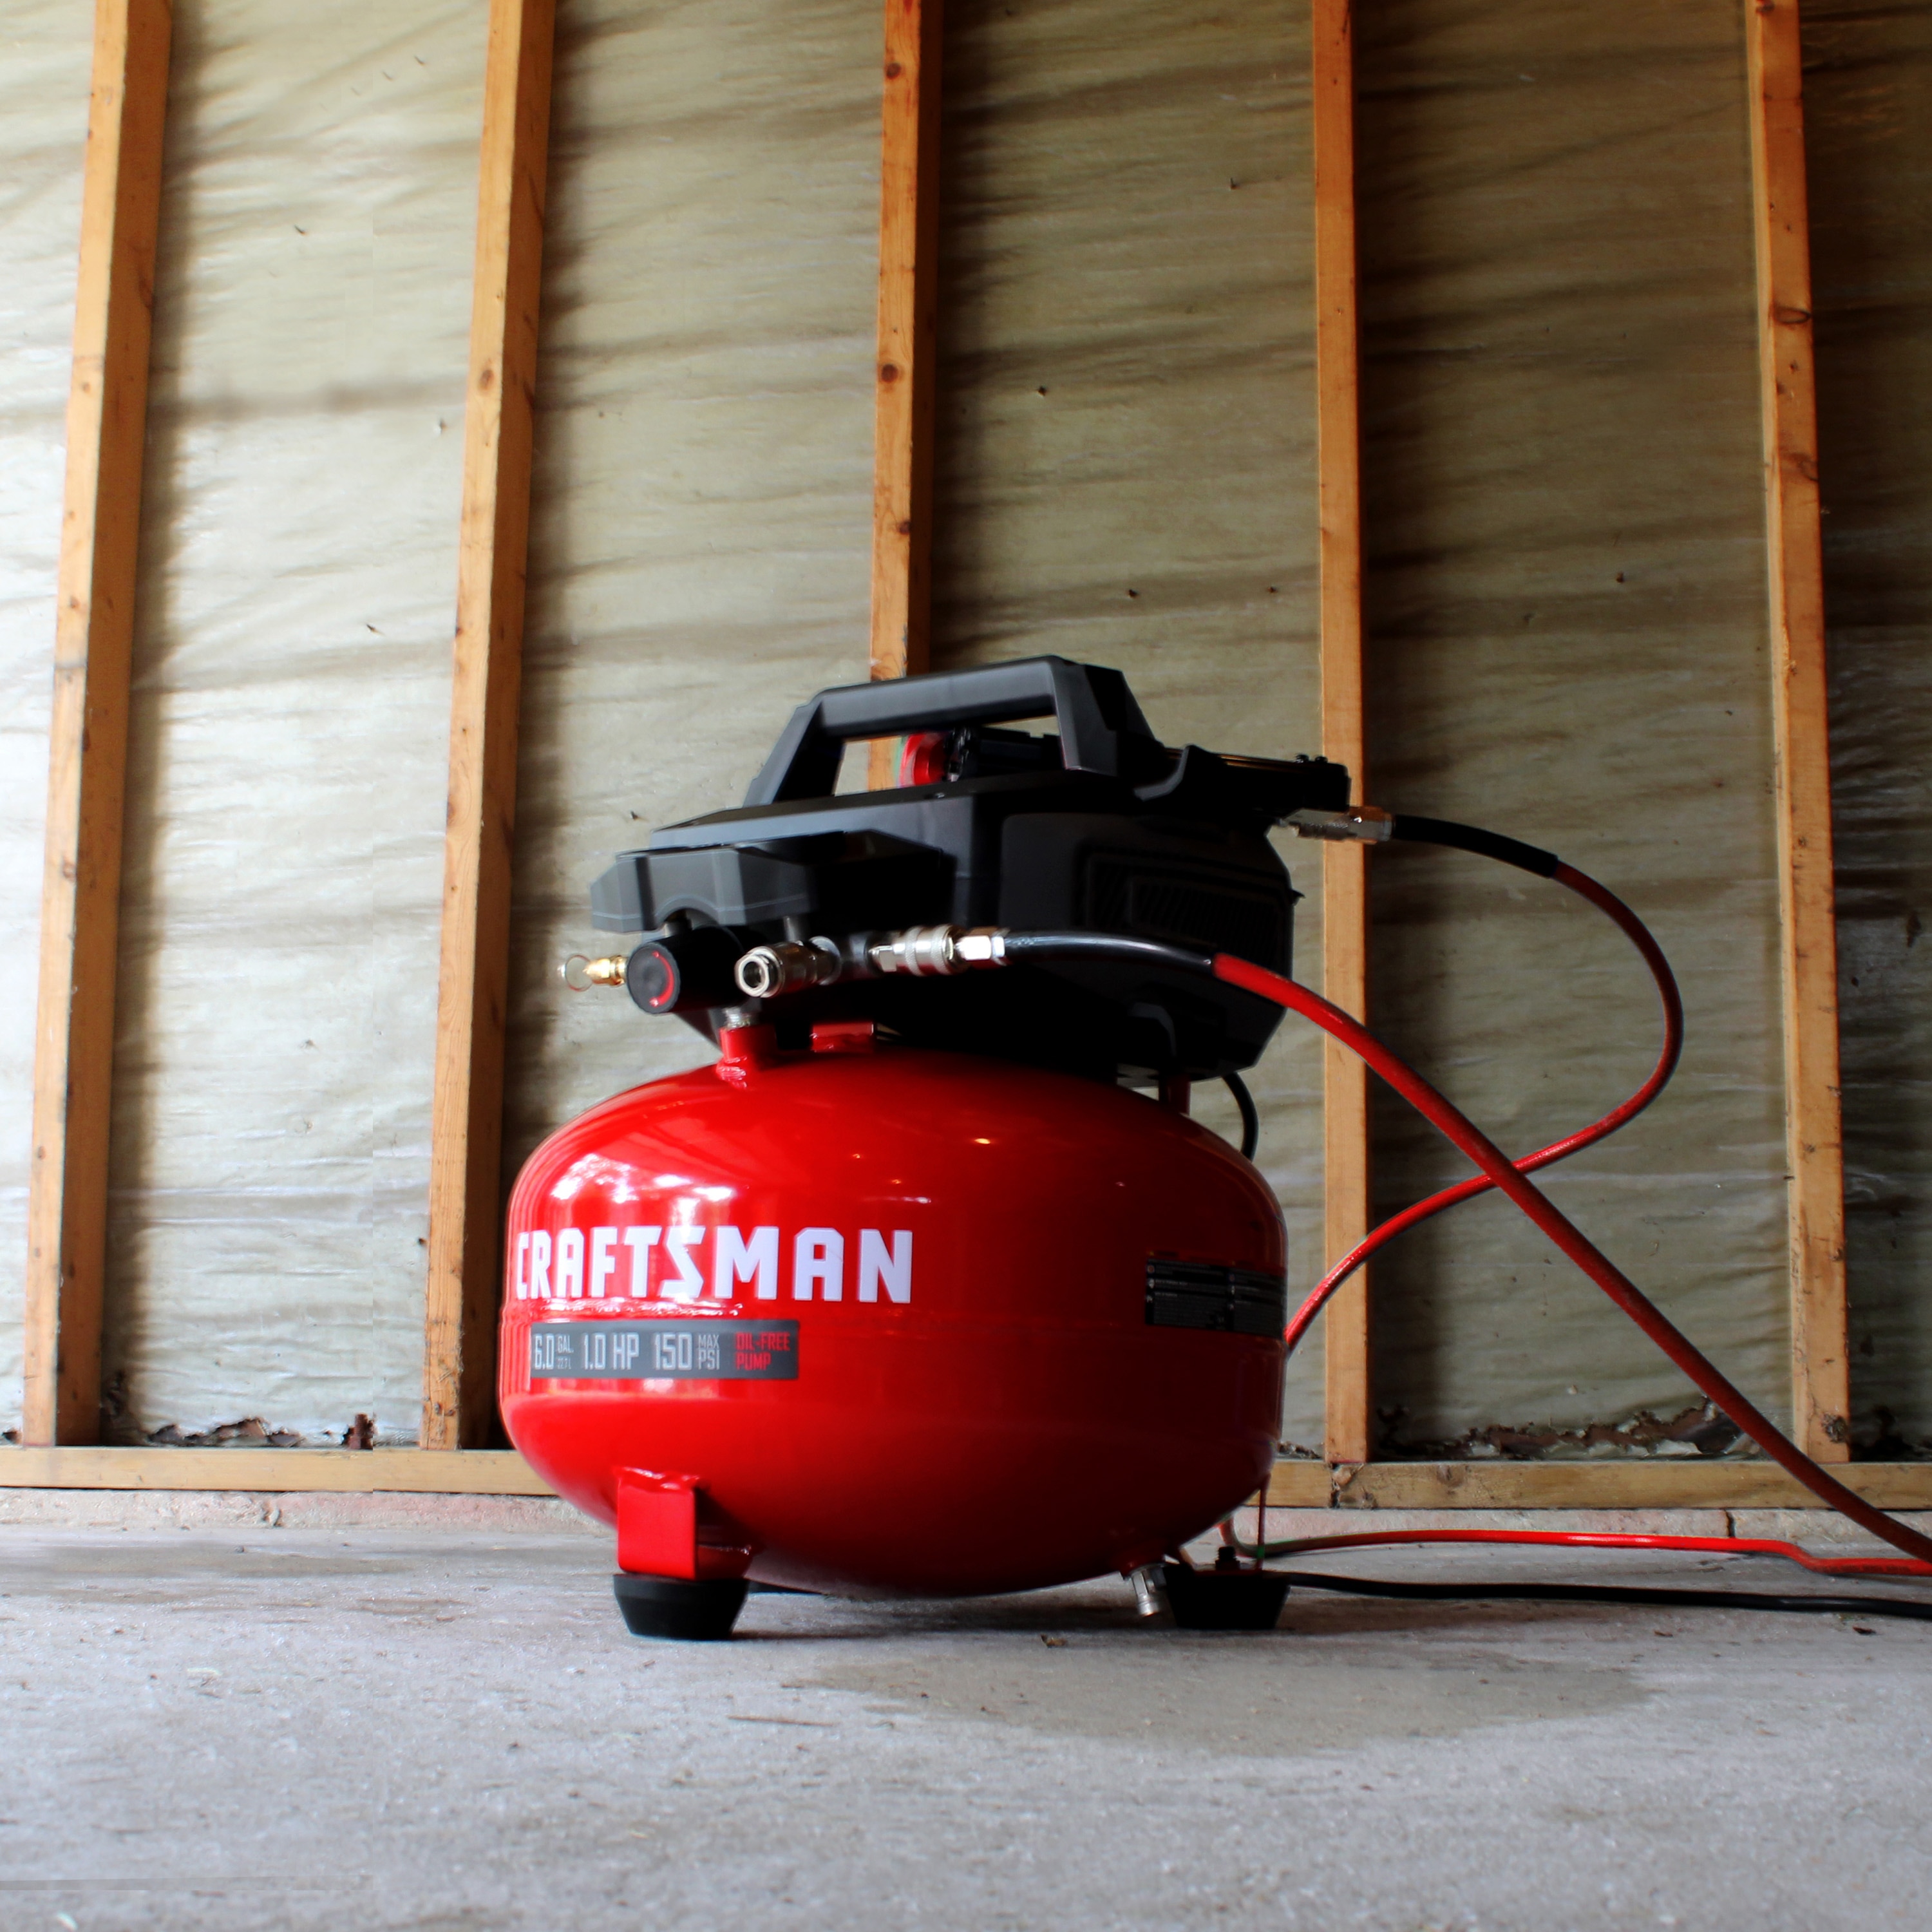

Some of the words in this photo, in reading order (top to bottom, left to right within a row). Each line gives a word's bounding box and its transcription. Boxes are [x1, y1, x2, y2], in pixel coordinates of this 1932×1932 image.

[516, 1226, 911, 1302] CRAFTSMAN
[535, 1334, 554, 1369] 6.0
[558, 1335, 574, 1353] GAL.
[584, 1333, 606, 1370] 1.0
[613, 1333, 639, 1370] HP
[654, 1333, 692, 1370] 150
[698, 1334, 719, 1349] MAX
[735, 1332, 790, 1350] OIL-FREE
[698, 1349, 720, 1370] PSI
[736, 1352, 771, 1370] PUMP
